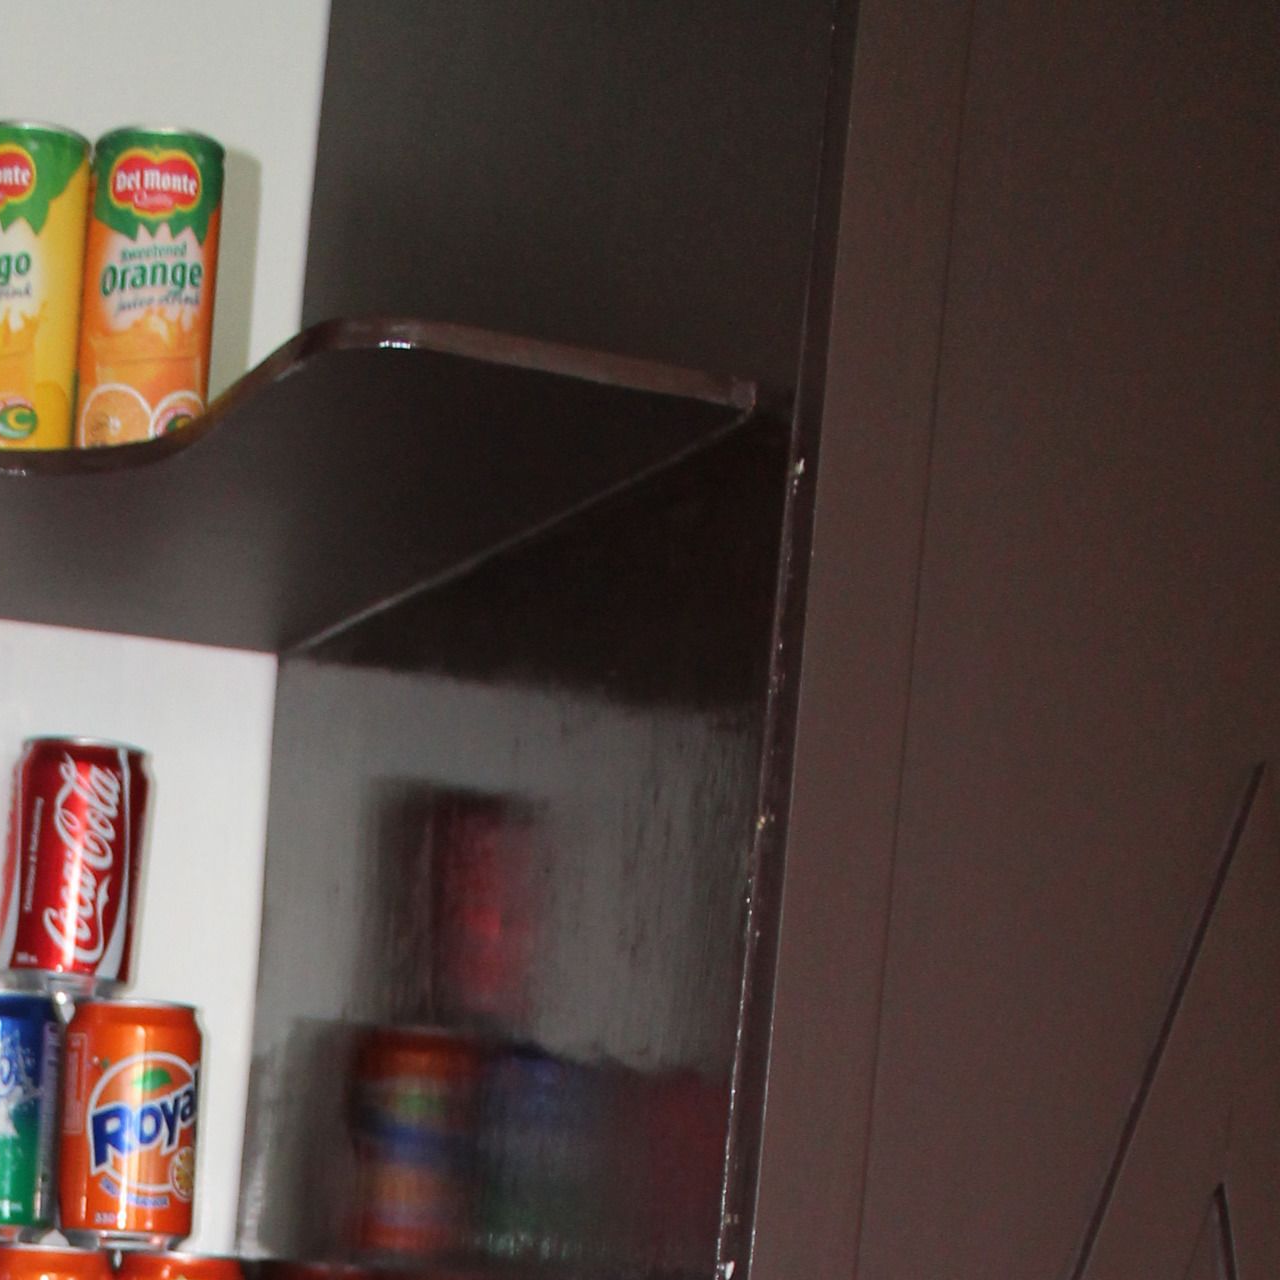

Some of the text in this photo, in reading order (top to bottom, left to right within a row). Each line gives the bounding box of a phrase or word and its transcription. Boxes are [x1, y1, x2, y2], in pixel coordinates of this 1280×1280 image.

[115, 169, 197, 196] Del Monte
[101, 261, 203, 296] Orange
[43, 750, 121, 964] Coca-Cola
